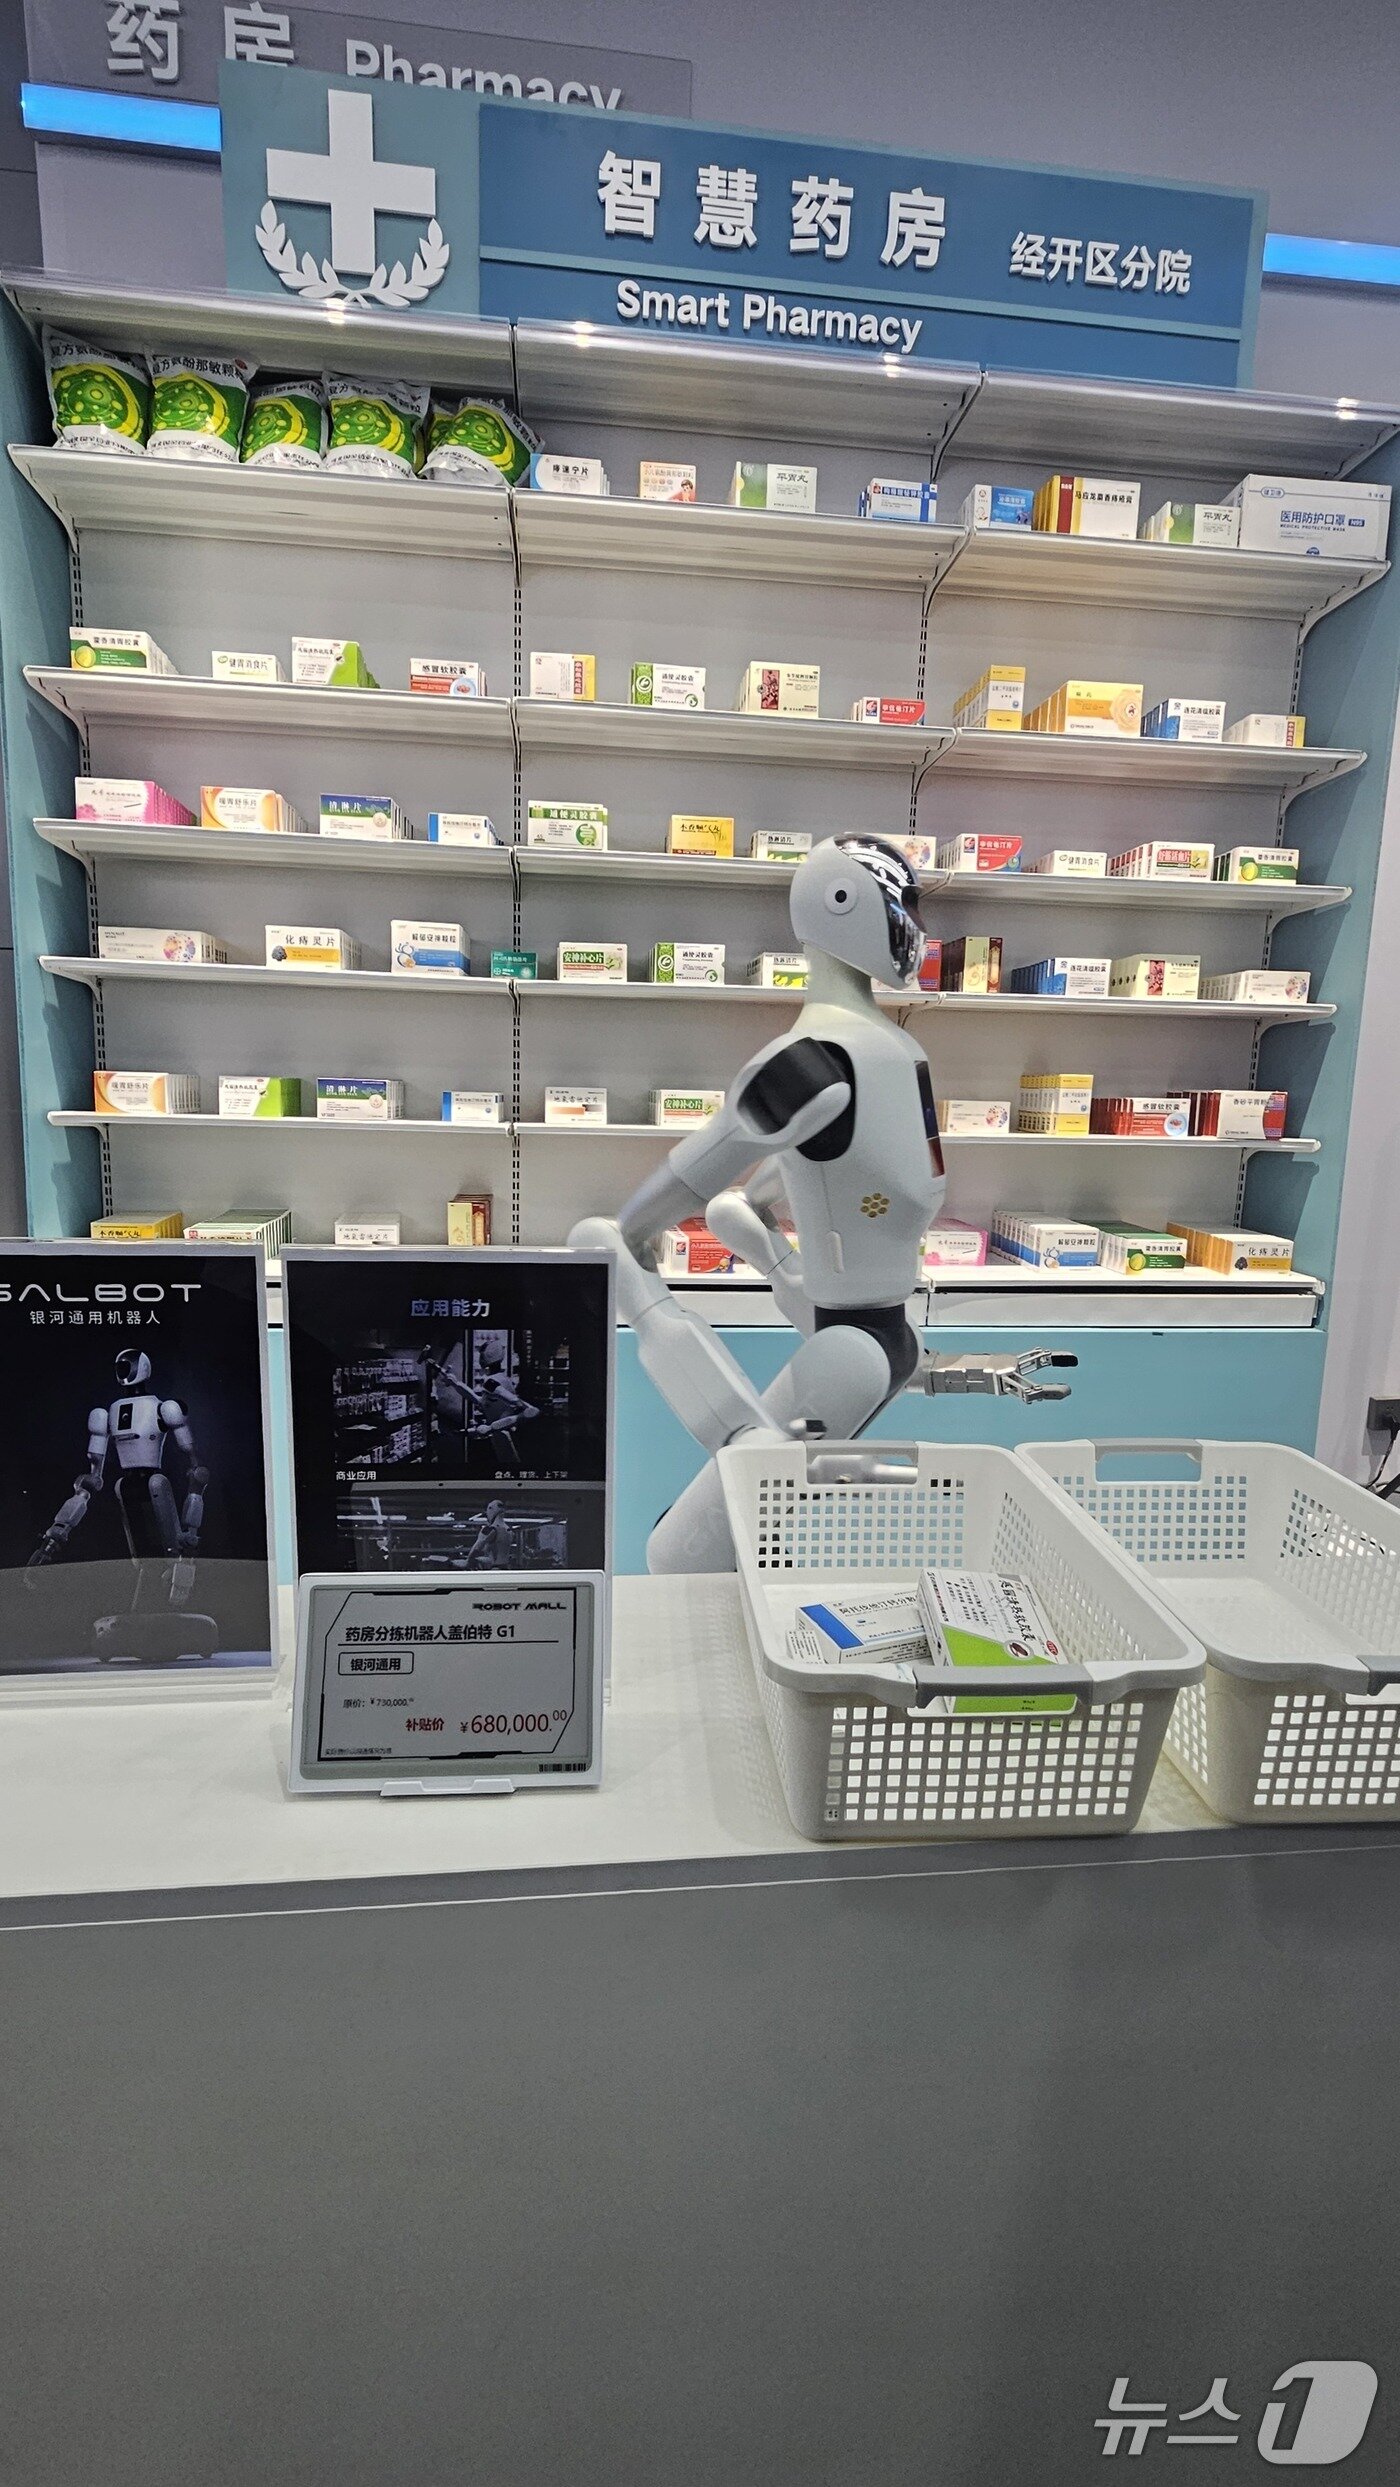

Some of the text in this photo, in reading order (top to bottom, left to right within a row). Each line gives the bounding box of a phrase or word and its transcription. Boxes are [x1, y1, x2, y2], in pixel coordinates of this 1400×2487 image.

[105, 0, 294, 81] 药房
[346, 38, 622, 110] Pharmacy
[597, 150, 1193, 295] 智慧药房 经开区分院
[616, 279, 923, 355] Smart Pharmacy
[1280, 510, 1346, 527] 医用防护口罩
[422, 665, 467, 676] 感冒软胶囊
[285, 934, 335, 947] 化痔灵片
[1248, 1247, 1290, 1258] 化痔灵片
[410, 1298, 491, 1318] 应用能力
[29, 1309, 161, 1326] 银河通用机器人
[335, 1470, 377, 1481] 商业应用
[472, 1602, 567, 1611] ROBOT MALL
[345, 1624, 516, 1642] 药房分拣机器人盖伯特 G1
[350, 1657, 402, 1672] 银河通用
[405, 1717, 445, 1732] 补贴价
